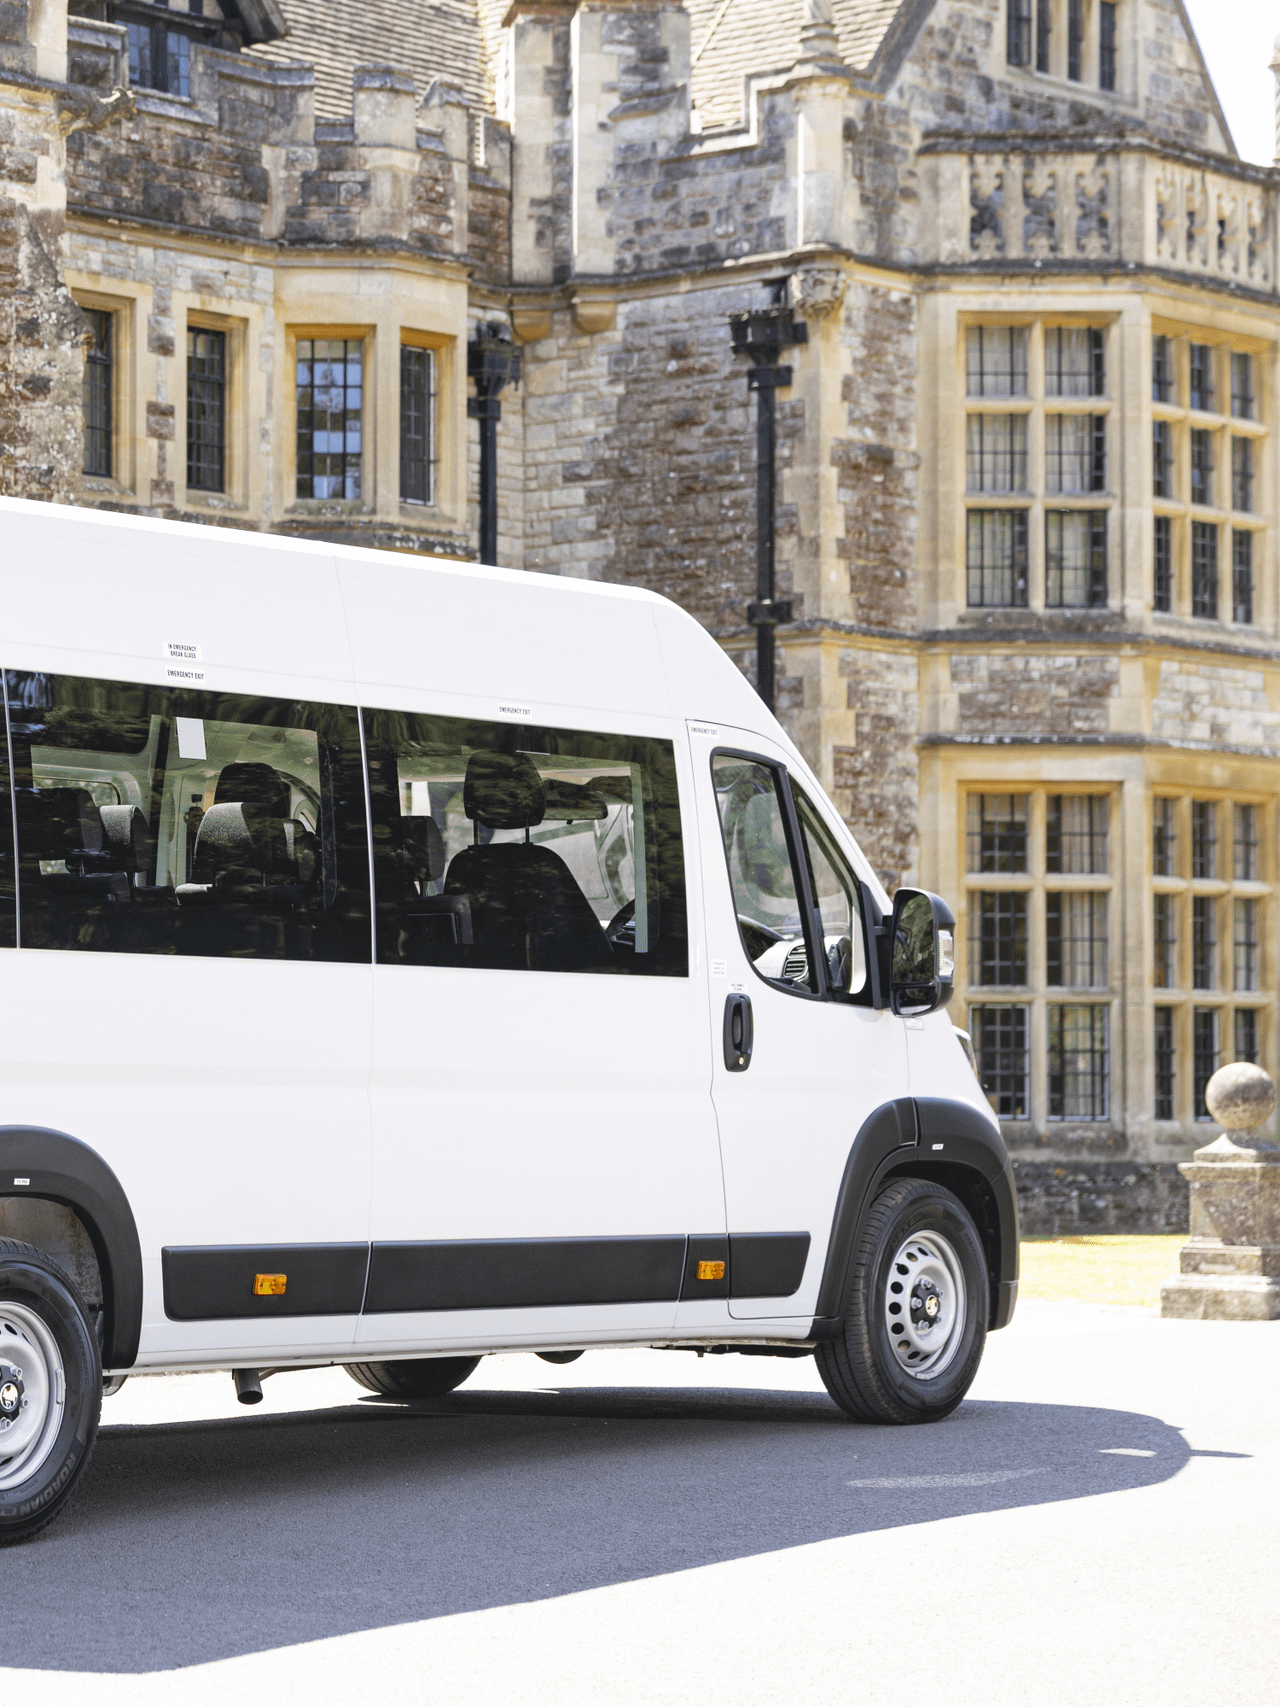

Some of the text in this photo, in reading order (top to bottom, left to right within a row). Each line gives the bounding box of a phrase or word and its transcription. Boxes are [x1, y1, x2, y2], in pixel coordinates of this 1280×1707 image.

[167, 670, 193, 678] EMERGENCY
[499, 706, 521, 714] EMERGENCY
[20, 1452, 78, 1516] ROADIAN
